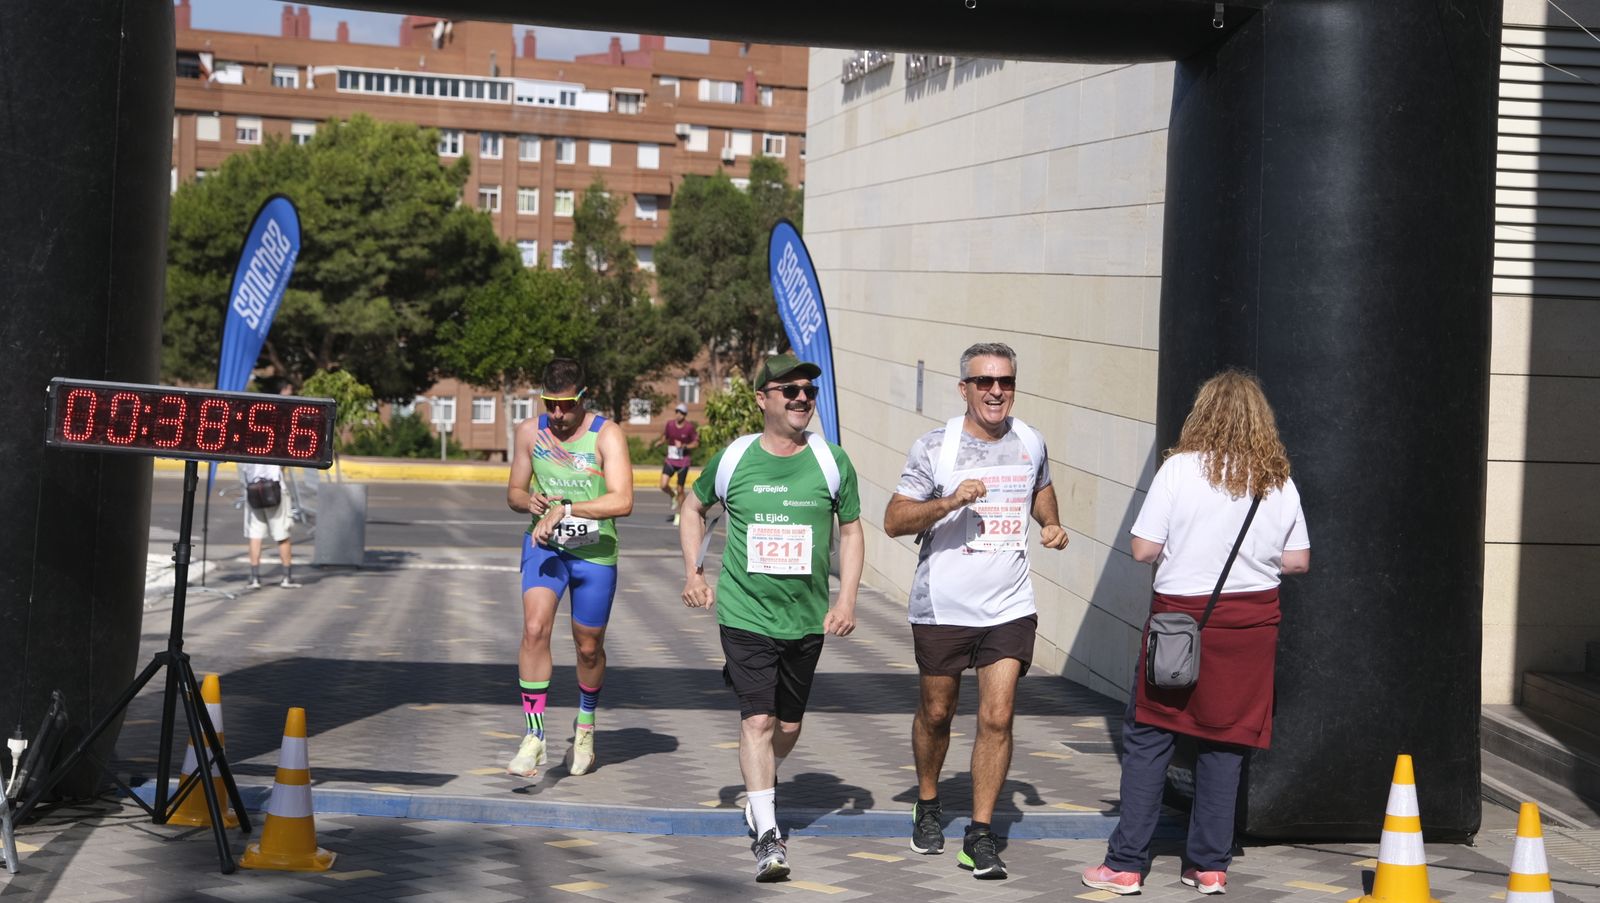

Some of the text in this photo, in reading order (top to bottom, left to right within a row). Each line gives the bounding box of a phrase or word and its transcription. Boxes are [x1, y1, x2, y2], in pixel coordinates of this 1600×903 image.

[63, 389, 319, 458] 00:38:56
[548, 477, 593, 488] SAKATA
[755, 513, 789, 524] El Ejido
[554, 523, 588, 537] 159
[976, 519, 1022, 535] 1282
[755, 541, 803, 557] 1211
